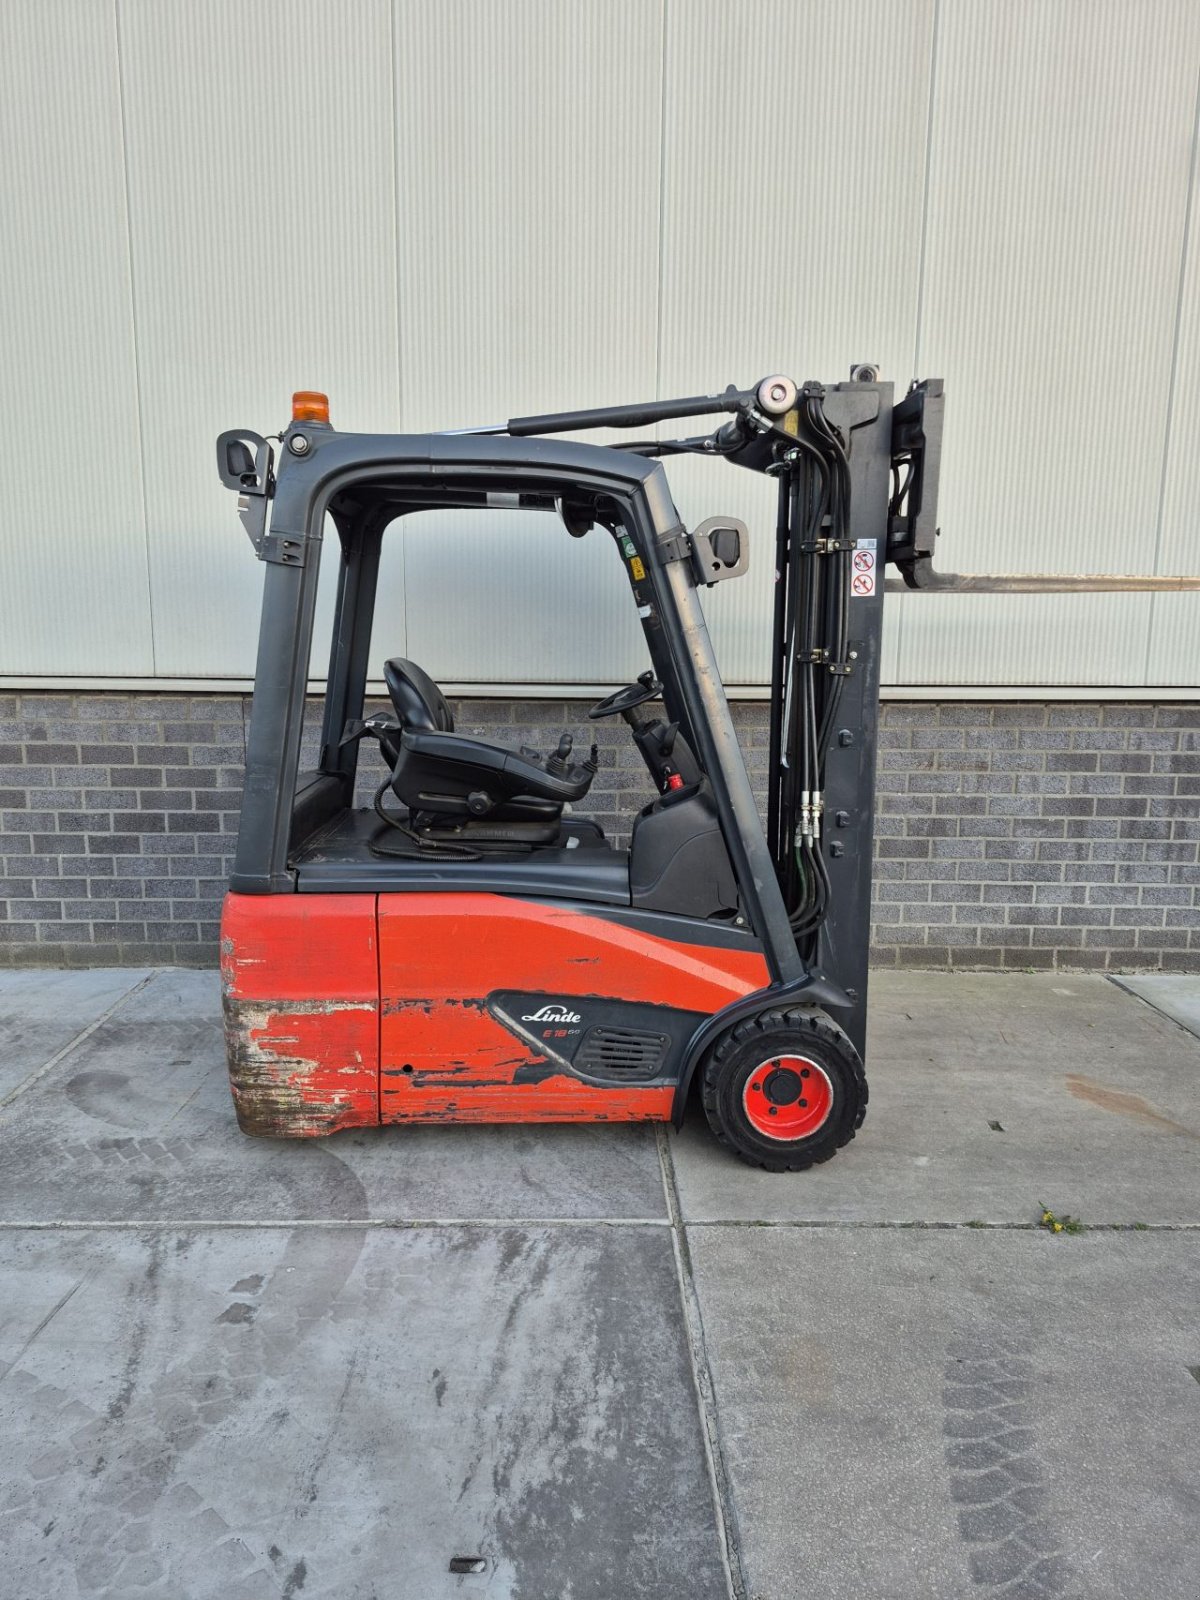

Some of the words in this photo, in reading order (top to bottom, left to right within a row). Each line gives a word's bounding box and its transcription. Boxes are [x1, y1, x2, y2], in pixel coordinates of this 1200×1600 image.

[521, 1005, 581, 1023] Linde
[543, 1029, 553, 1038] E
[554, 1029, 567, 1038] 18
